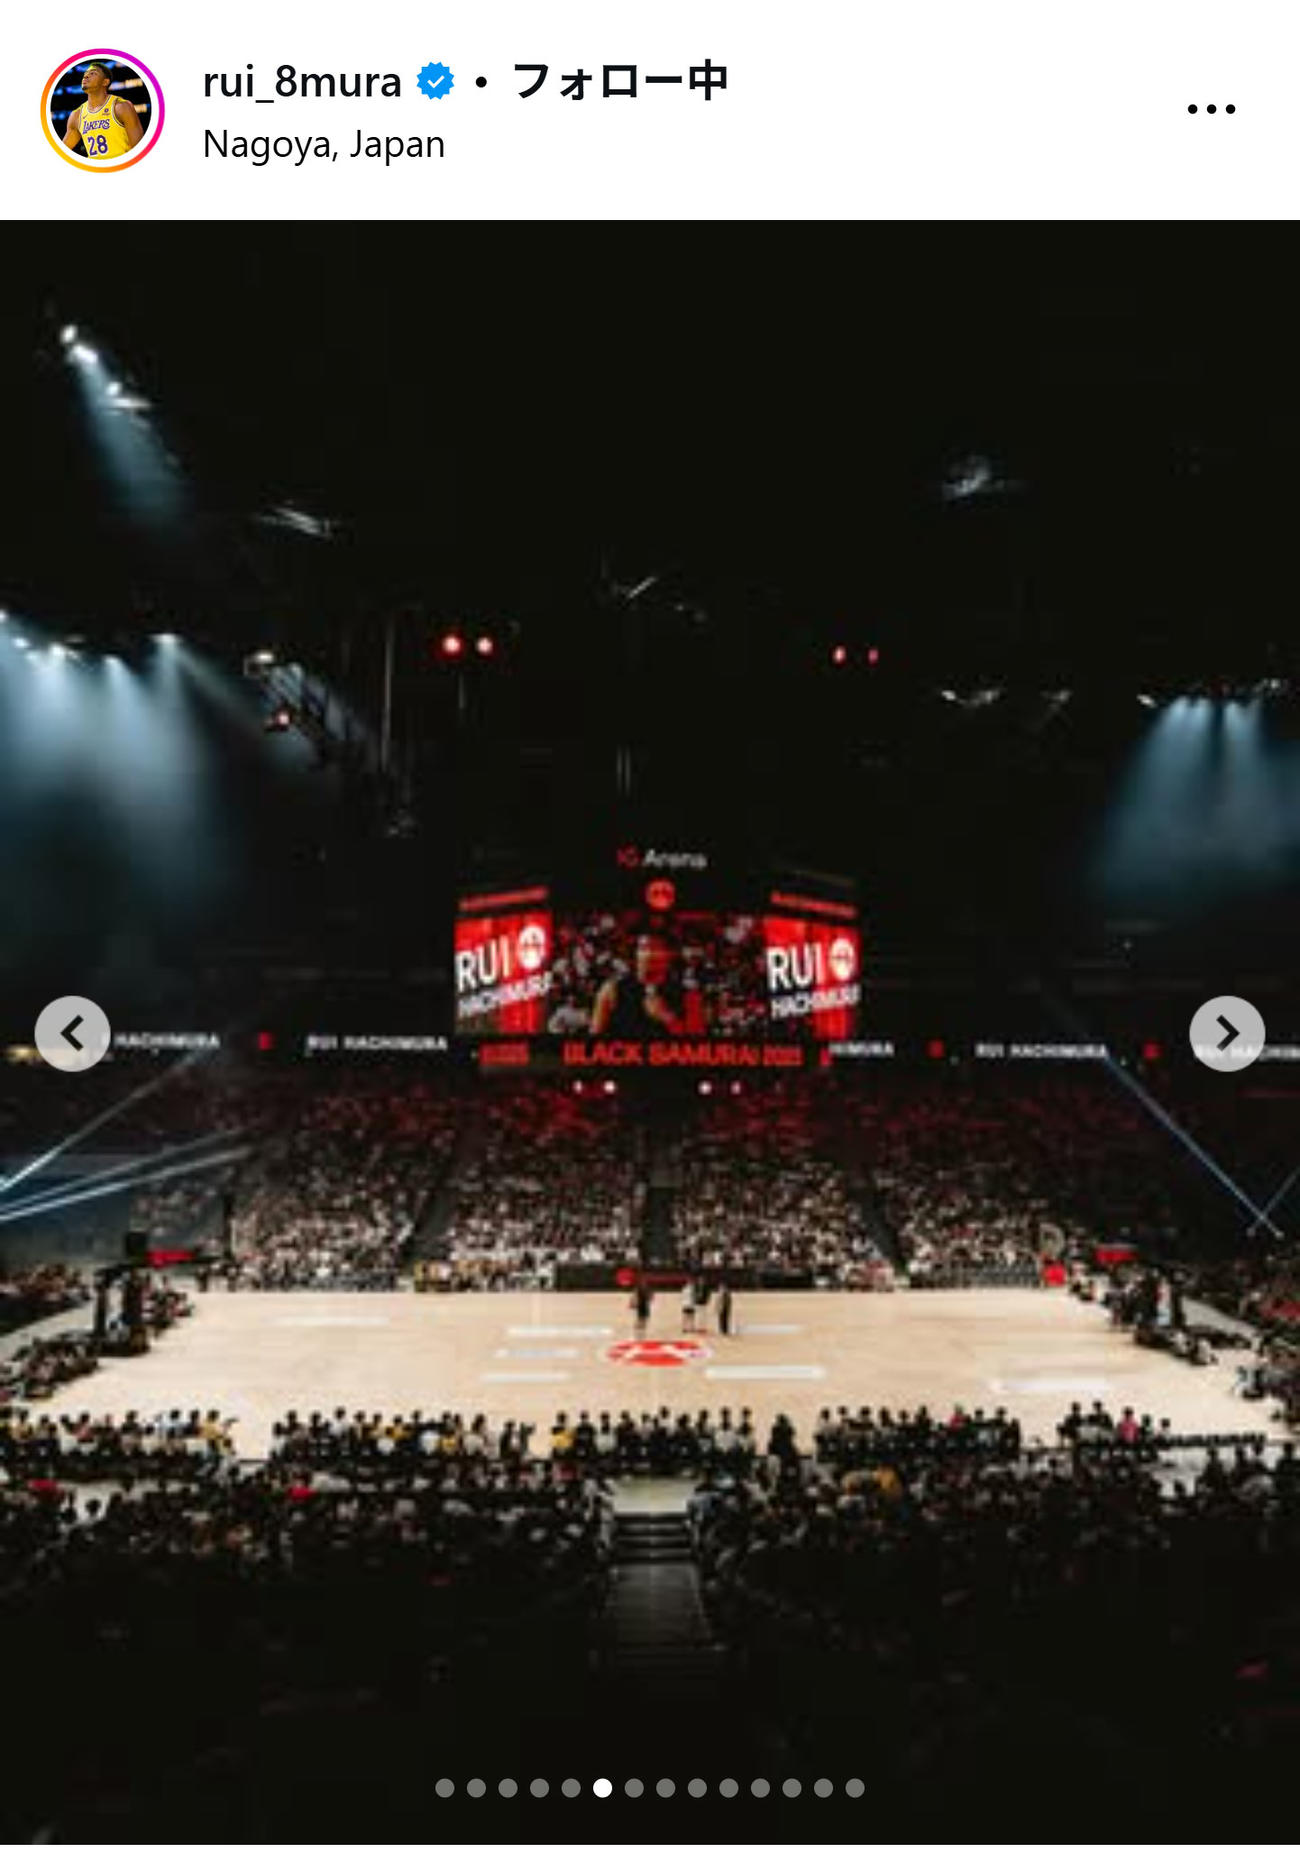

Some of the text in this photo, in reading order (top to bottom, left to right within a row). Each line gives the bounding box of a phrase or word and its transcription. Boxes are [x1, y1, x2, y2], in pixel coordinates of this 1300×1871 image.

[87, 134, 109, 156] 28
[455, 935, 510, 992] RUI
[767, 942, 826, 991] RUI
[563, 1041, 643, 1065] BLACK
